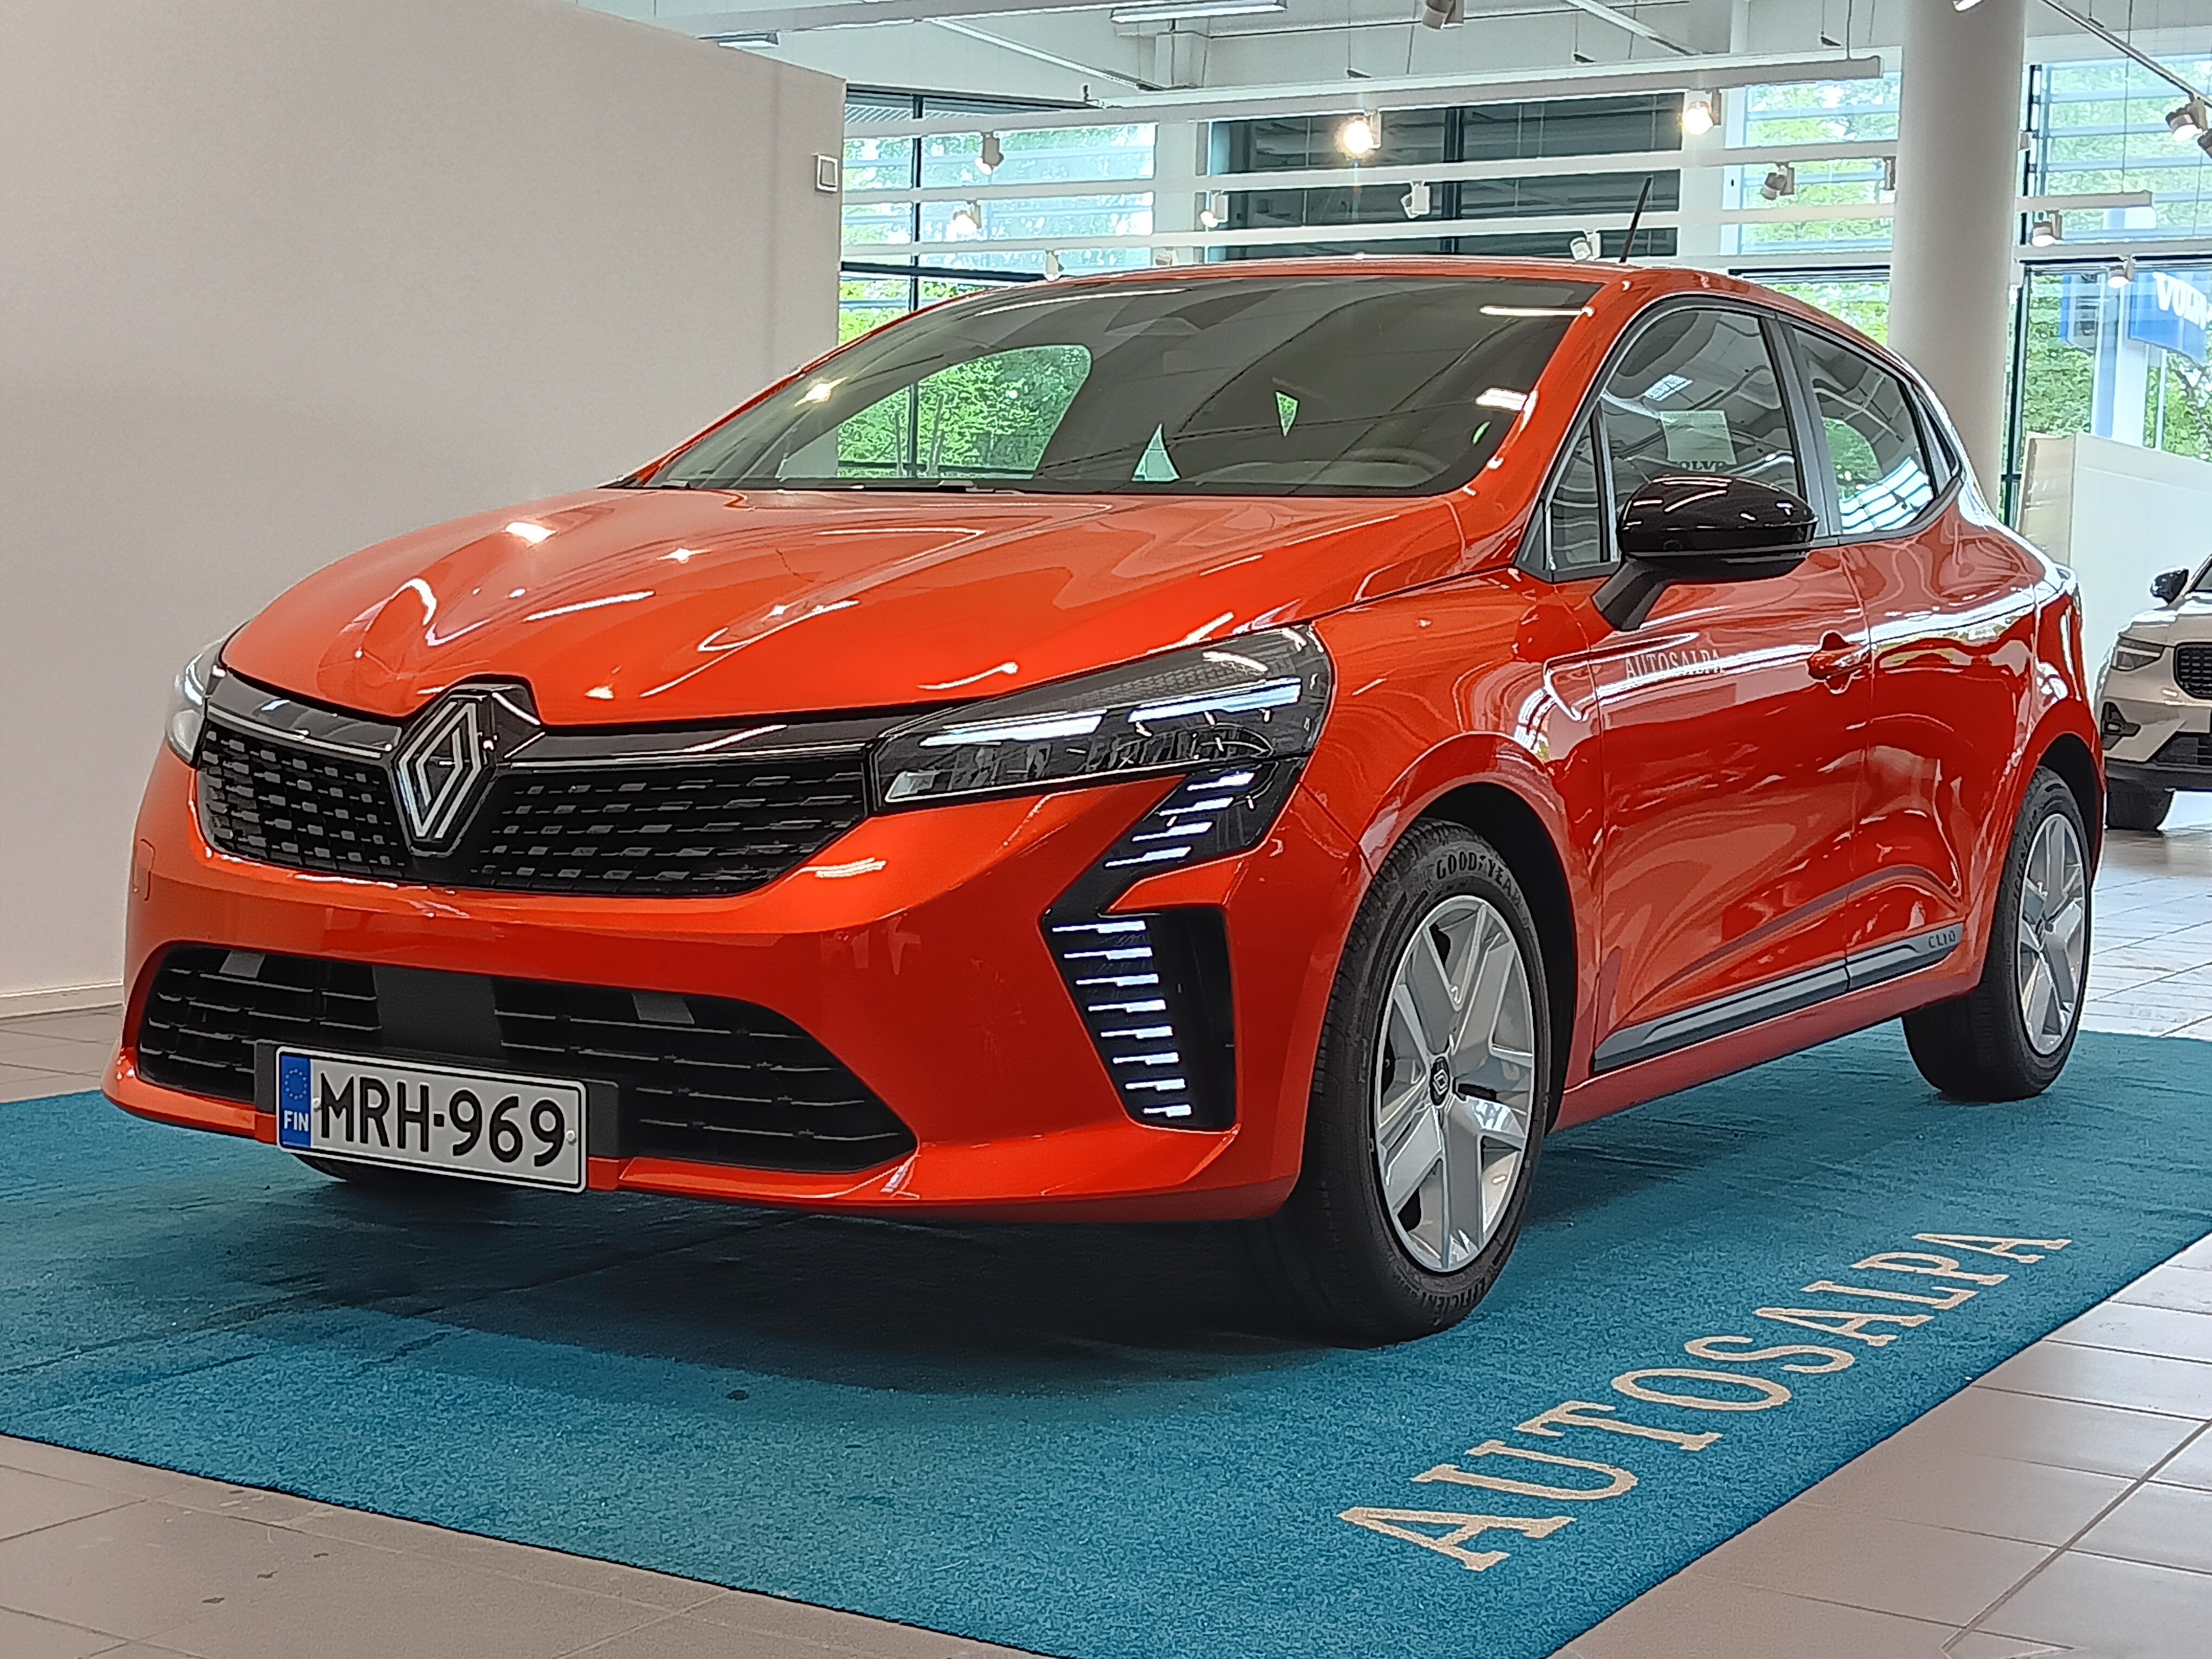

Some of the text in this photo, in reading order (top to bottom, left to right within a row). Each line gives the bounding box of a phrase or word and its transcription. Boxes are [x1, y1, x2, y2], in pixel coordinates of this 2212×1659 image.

[1928, 929, 1956, 949] CLIO
[284, 1110, 309, 1133] FIN
[320, 1072, 566, 1168] MRH-969
[1338, 1232, 2073, 1572] AUTOSALPA
